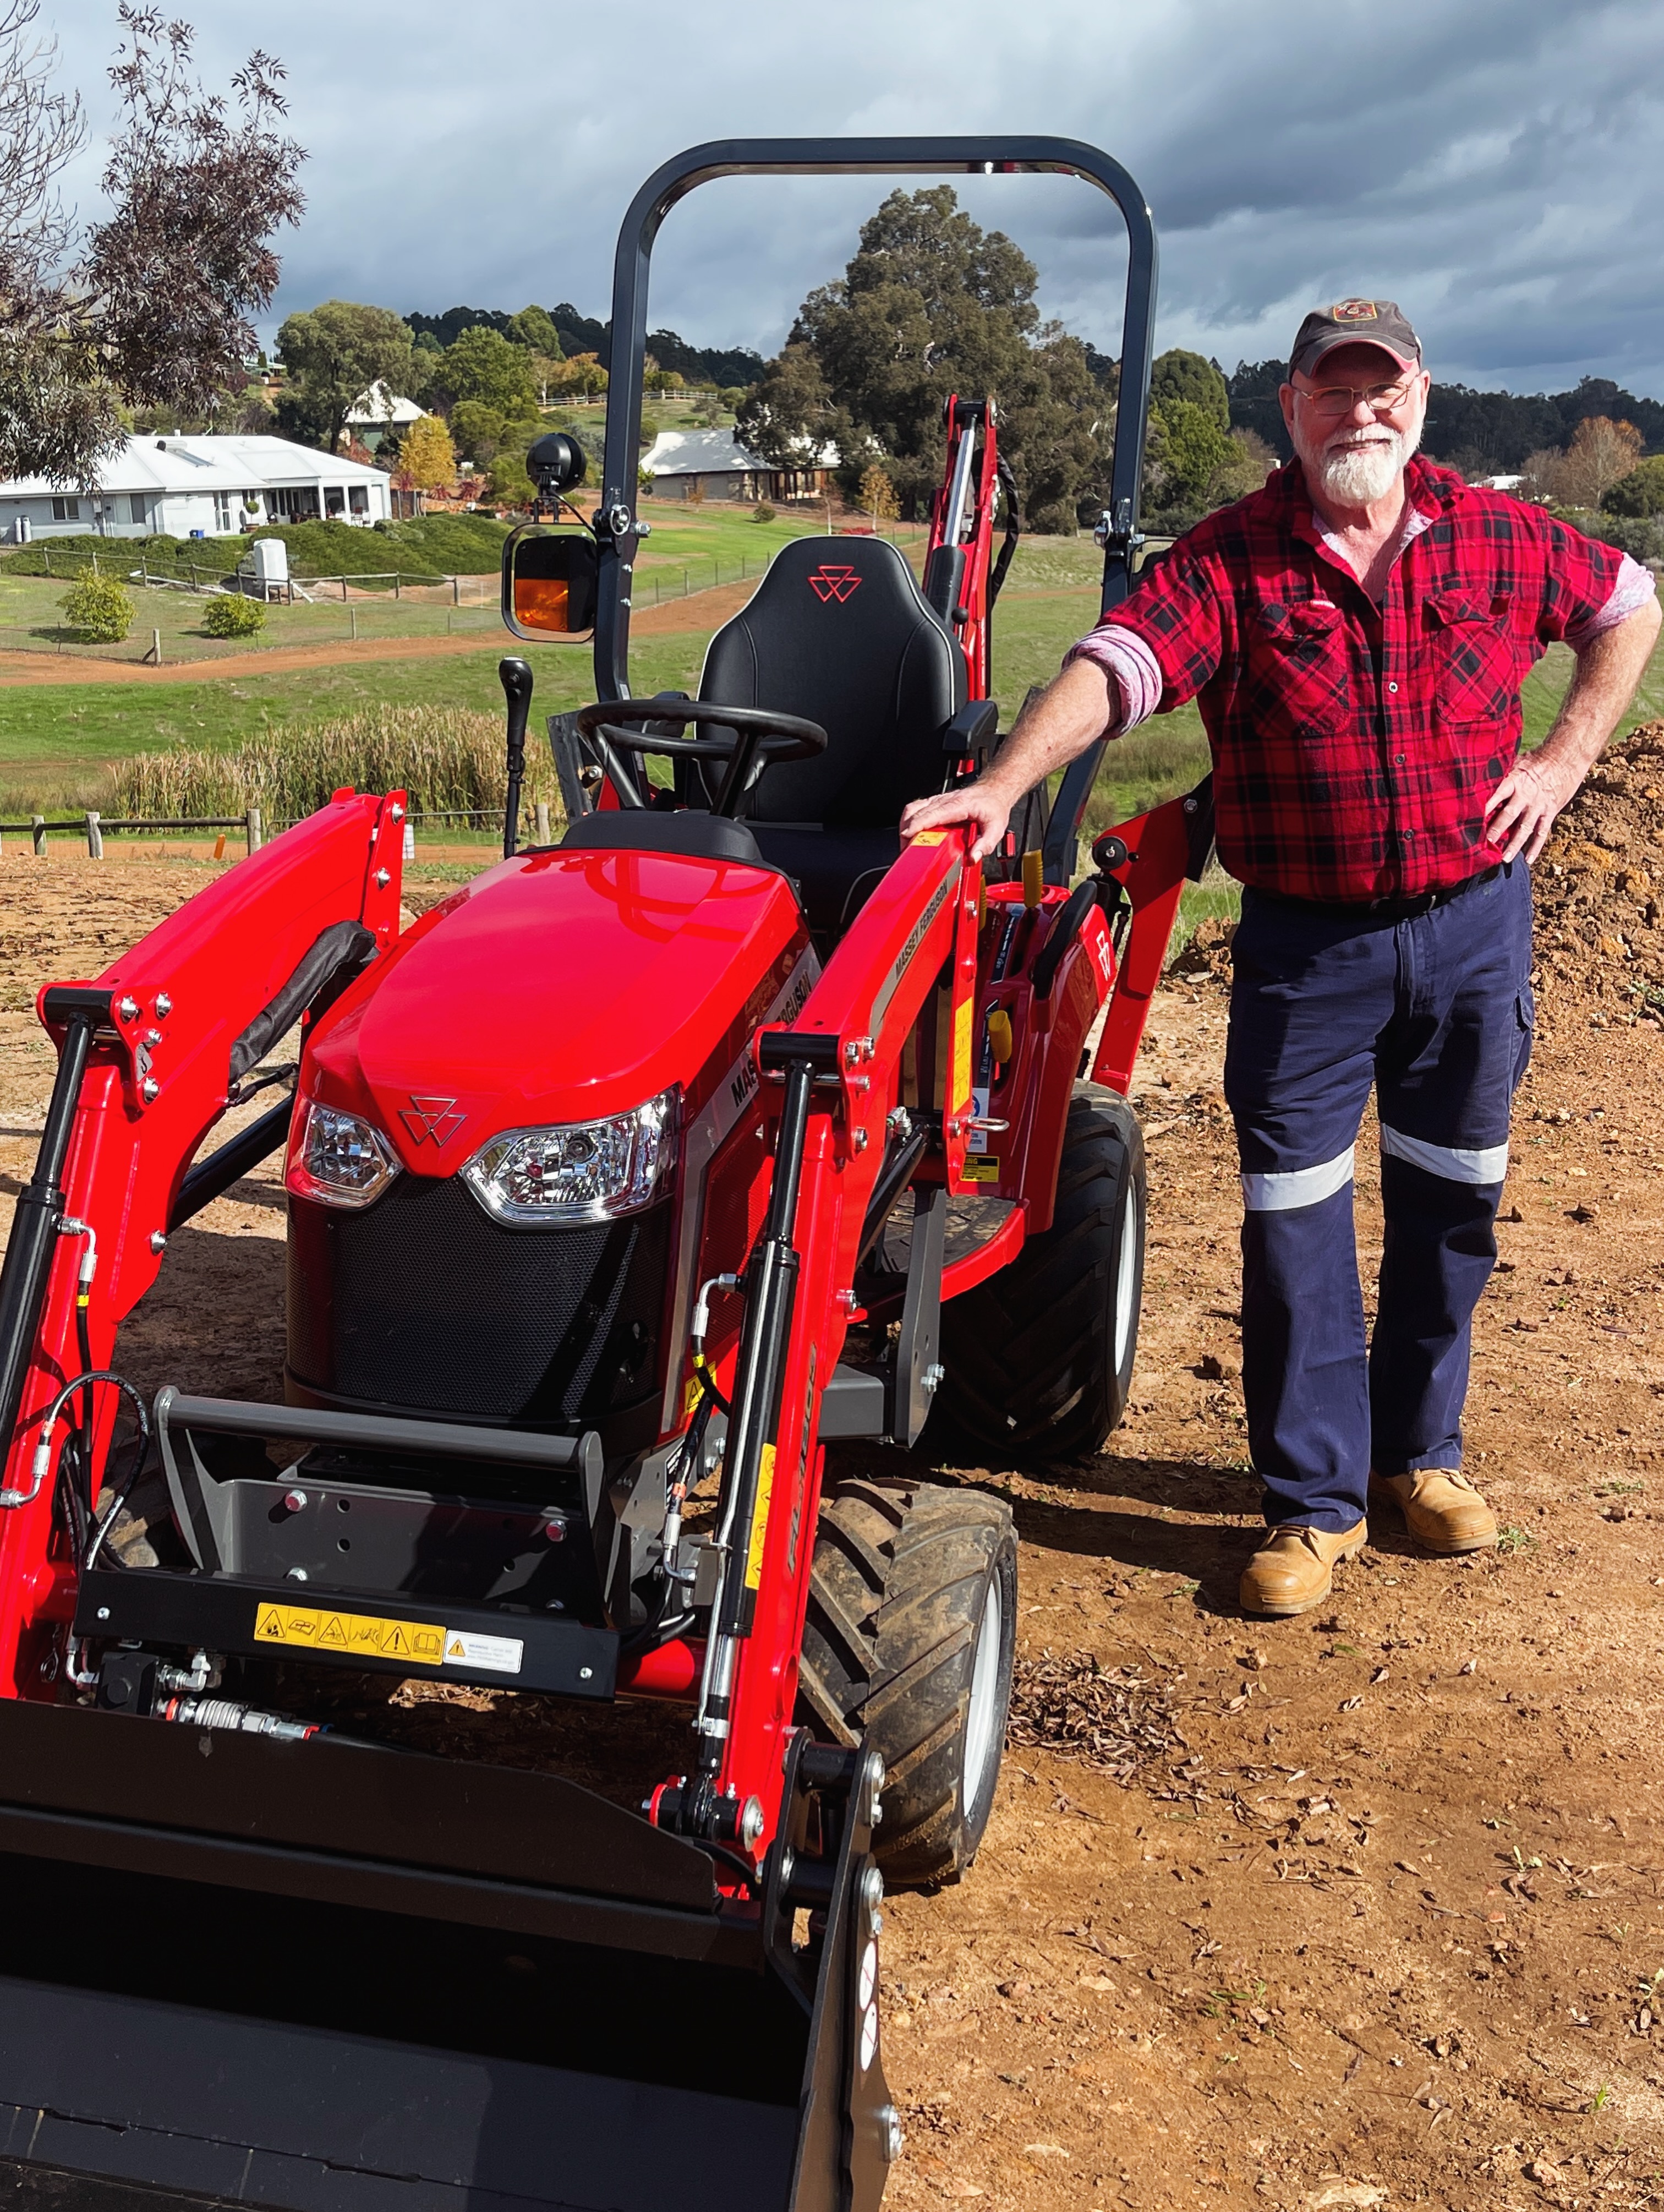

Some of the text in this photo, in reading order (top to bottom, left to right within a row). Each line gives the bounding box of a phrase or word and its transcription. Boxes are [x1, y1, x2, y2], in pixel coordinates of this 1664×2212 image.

[895, 878, 948, 980] MASSEY FERGUSON
[731, 1059, 757, 1107] MAS
